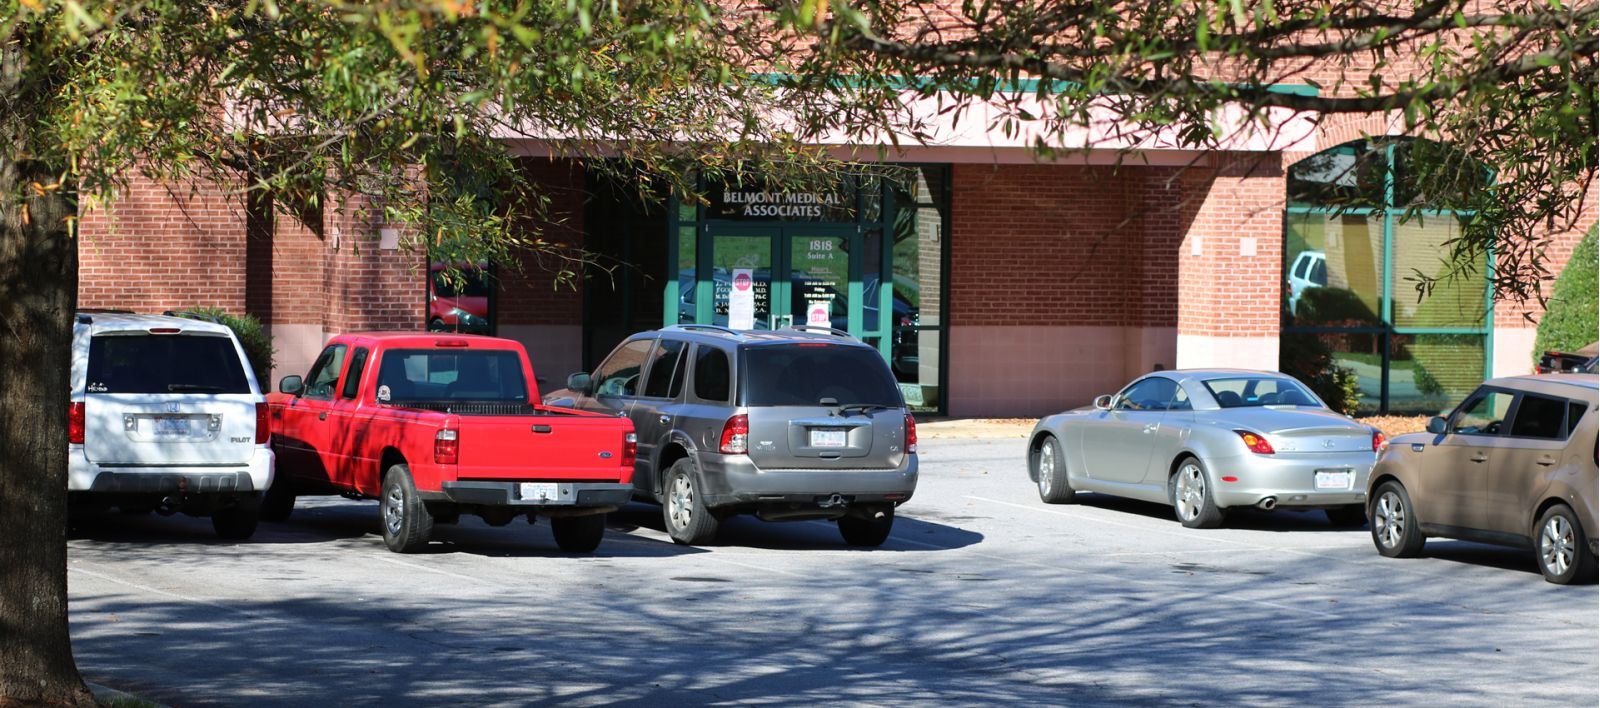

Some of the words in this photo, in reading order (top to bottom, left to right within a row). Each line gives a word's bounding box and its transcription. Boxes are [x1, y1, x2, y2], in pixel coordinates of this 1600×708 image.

[723, 192, 781, 203] BELMONT
[744, 205, 821, 216] ASSOCIATES
[809, 240, 833, 251] 1818
[808, 252, 825, 260] Suite
[735, 278, 750, 287] STOP
[811, 313, 826, 321] STOP
